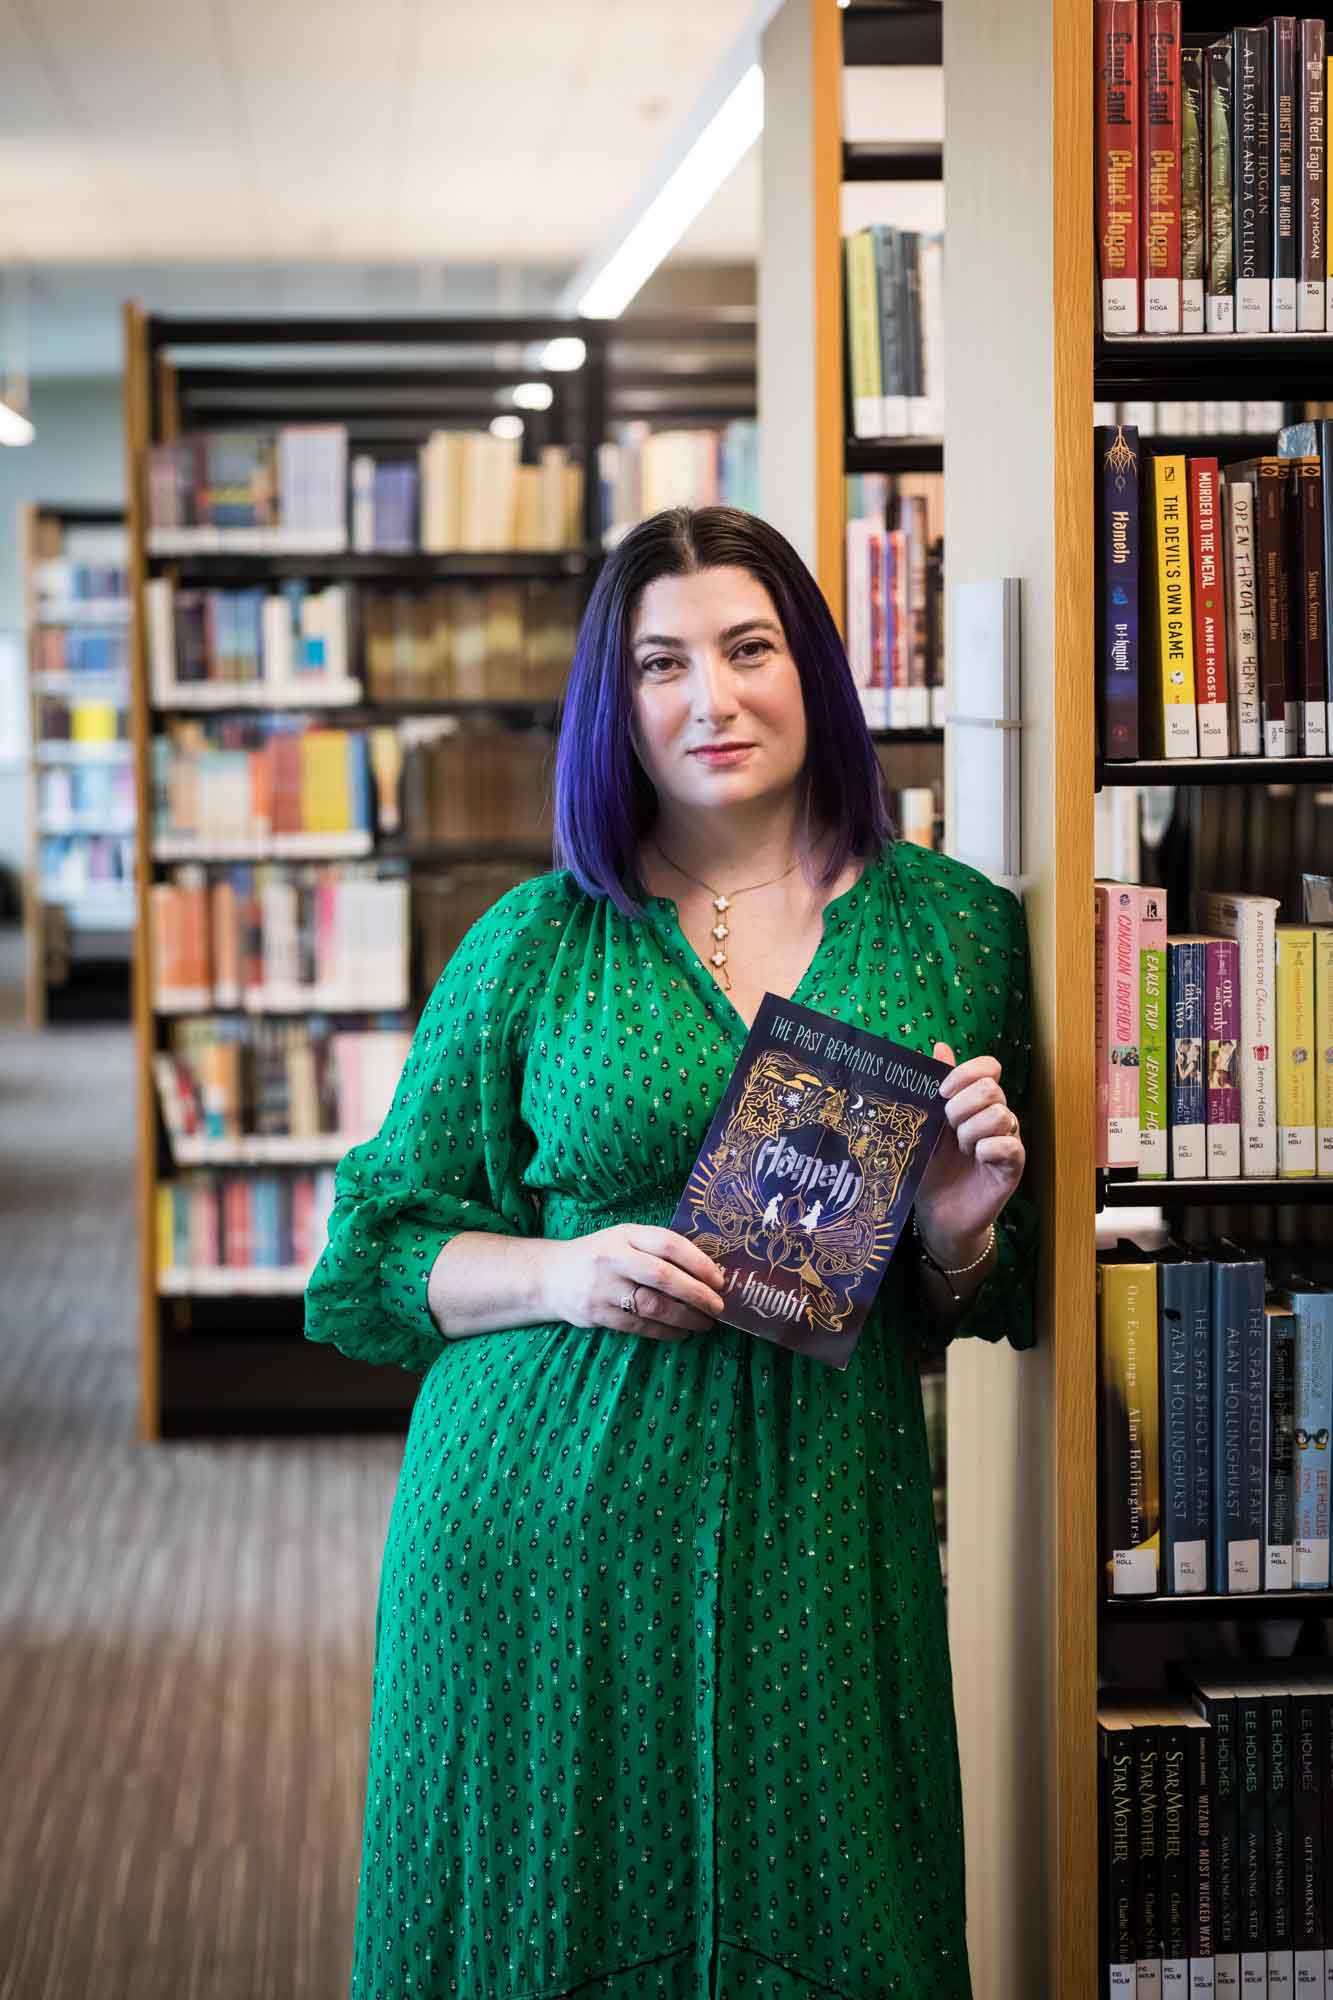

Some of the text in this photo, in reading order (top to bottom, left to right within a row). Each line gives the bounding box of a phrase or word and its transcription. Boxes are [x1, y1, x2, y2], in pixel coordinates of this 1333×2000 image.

[1186, 86, 1200, 113] Left
[1214, 86, 1230, 113] Left
[1309, 90, 1323, 112] The
[1279, 96, 1292, 176] AGAINST THE LAW
[1309, 118, 1323, 142] Red
[1242, 48, 1256, 278] A PLEASURE AND A CALLING
[1257, 113, 1269, 214] PHIL HOGAN
[1306, 147, 1323, 181] Eagle
[1103, 150, 1133, 268] Chuck Hogan
[1147, 150, 1176, 268] Chuck Hogan
[1186, 210, 1198, 245] MARY
[1279, 185, 1292, 237] RAY HOGAN
[1310, 198, 1321, 259] RAY HOGAN
[1215, 209, 1228, 295] MARY HOGAN
[1112, 511, 1131, 564] Hameln
[1198, 472, 1216, 589] MURDER TO THE METAL
[1234, 500, 1255, 618] OPEN THROAT
[1163, 496, 1184, 660] THE DEVIL'S OWN GAME
[1204, 616, 1215, 653] ANNIE
[1238, 655, 1257, 695] HENRY
[1256, 919, 1264, 964] PRINCESS
[1117, 914, 1132, 1042] CANADIAN BOYFRIEND
[1145, 954, 1160, 1031] EARLS TRIP
[1186, 984, 1201, 1020] takes
[1223, 980, 1234, 1008] one
[1176, 1002, 1185, 1028] two
[1211, 1001, 1228, 1033] only
[769, 1015, 941, 1099] THE PAST REMAINS UNSUNG
[1145, 1055, 1160, 1104] JENNY
[1255, 1066, 1266, 1094] Jenny
[1126, 1285, 1140, 1387] Our Evenings
[1276, 1326, 1289, 1344] The
[1171, 1327, 1187, 1520] ALAN HOLLINGHURST
[1194, 1306, 1208, 1526] THE SPARSHOLT AFFAIR
[1226, 1327, 1241, 1518] ALAN HOLLINGHURST
[1248, 1306, 1262, 1527] THE SPARSHOLT AFFAIR
[1127, 1407, 1143, 1543] Alan Hollinghurst
[1274, 1467, 1286, 1489] Alan
[1216, 1737, 1230, 1794] HOLMES
[1245, 1735, 1257, 1792] HOLMES
[1272, 1733, 1283, 1790] HOLMES
[1301, 1732, 1313, 1790] HOLMES
[1112, 1755, 1132, 1864] STAR MOTHER
[1139, 1751, 1158, 1861] STAR MOTHER
[1165, 1751, 1184, 1861] STAR MOTHER
[1198, 1794, 1209, 1835] WIZARD
[1199, 1848, 1210, 1876] MOST
[1249, 1832, 1258, 1897] AWAKENING
[1199, 1880, 1211, 1921] WICKED
[1304, 1873, 1314, 1934] DARKNESS
[1200, 1925, 1211, 1954] WAYS
